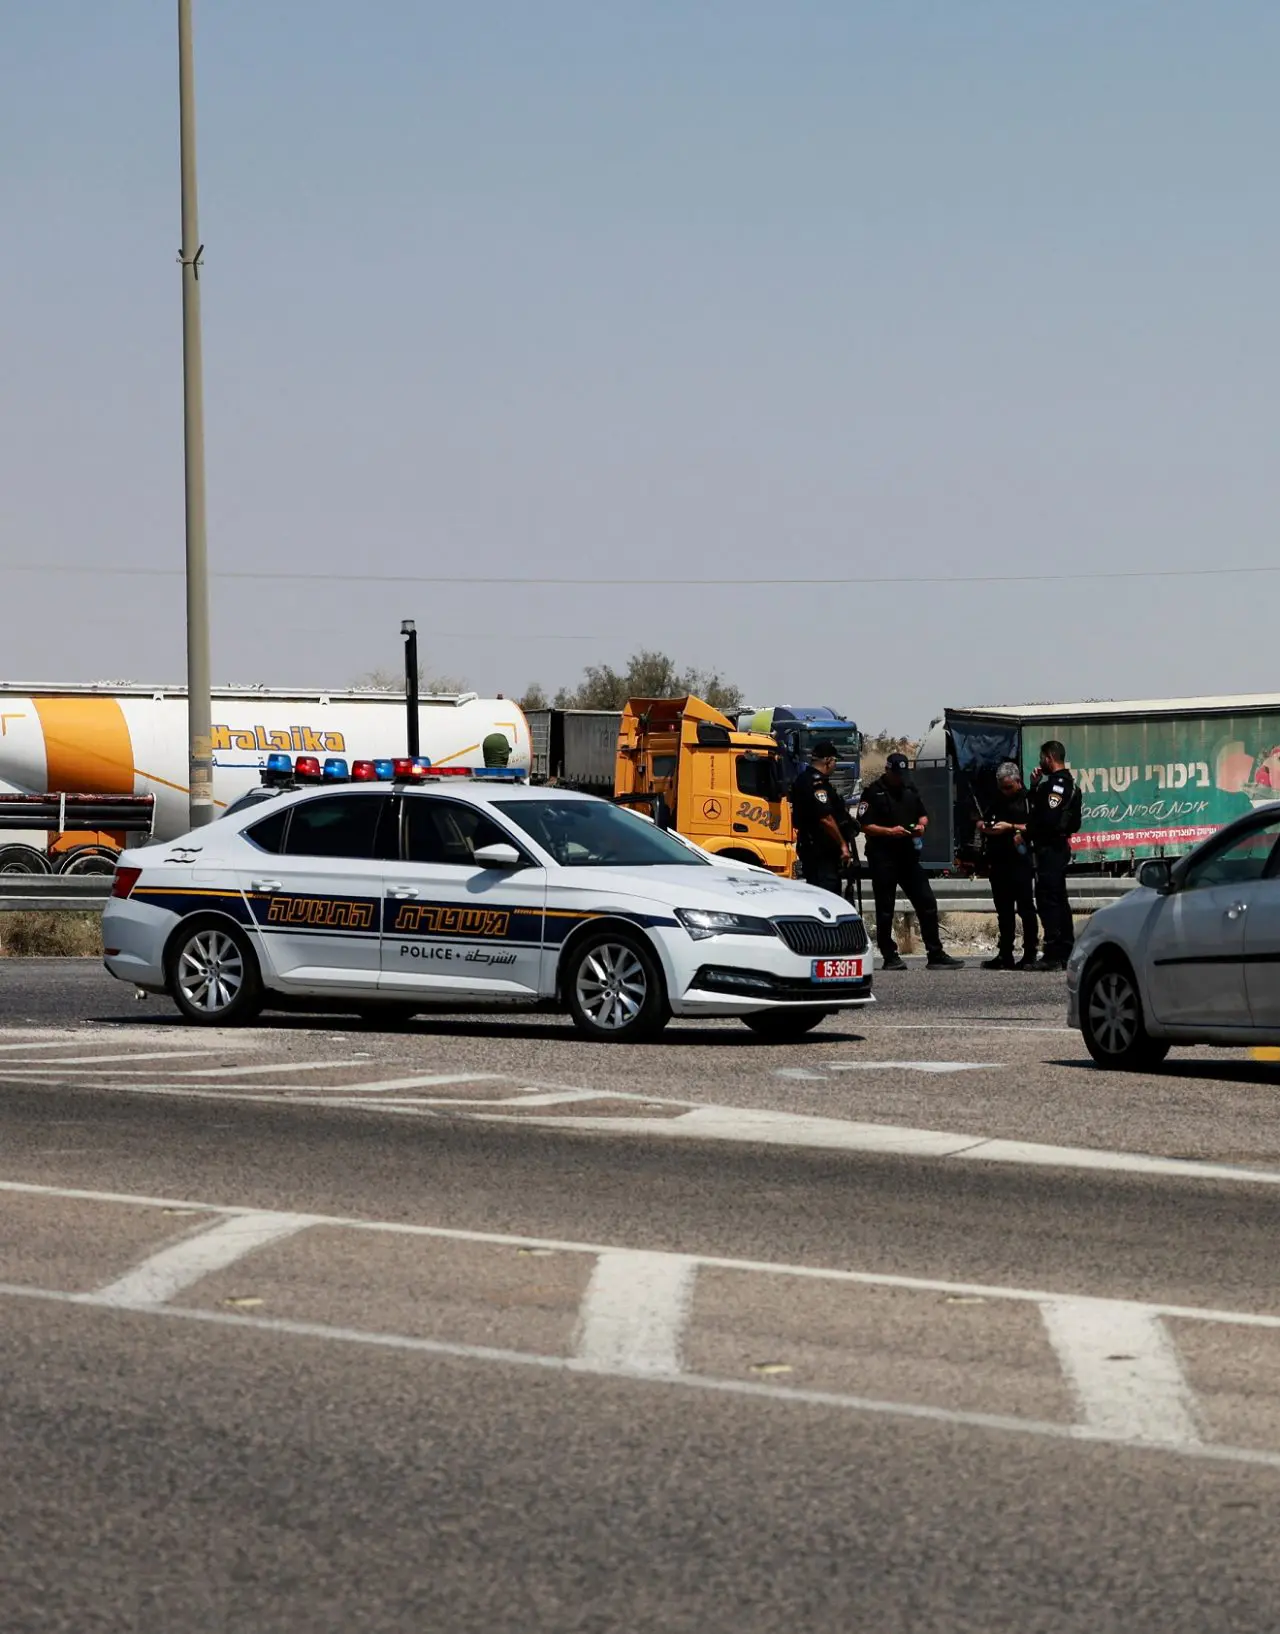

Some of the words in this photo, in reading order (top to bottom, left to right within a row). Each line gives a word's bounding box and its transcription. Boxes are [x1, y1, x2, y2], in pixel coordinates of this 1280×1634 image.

[1144, 761, 1210, 789] ביכורי
[1081, 803, 1119, 820] מהטב
[267, 896, 374, 928] התנועה
[394, 905, 510, 936] משטרת
[400, 945, 453, 960] POLICE
[464, 949, 518, 967] الشرطة
